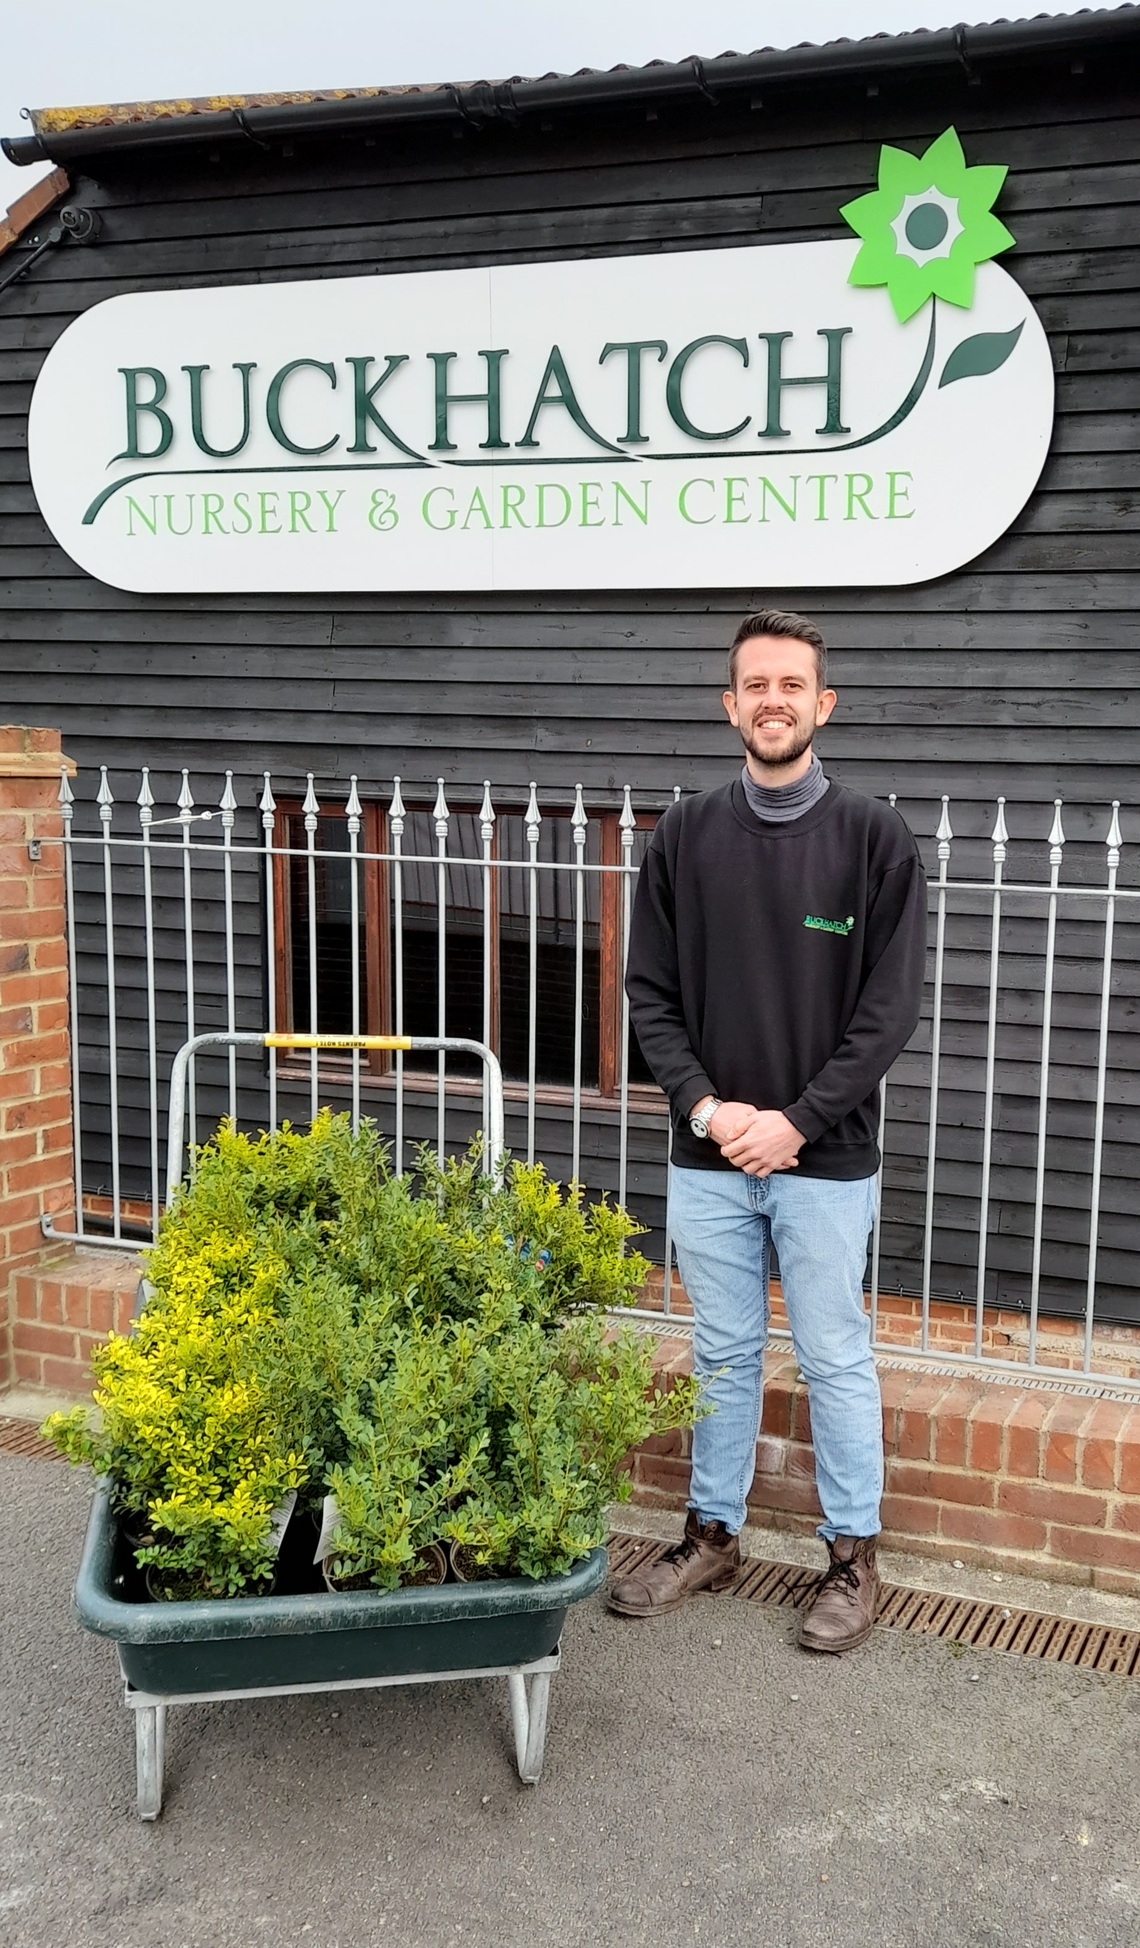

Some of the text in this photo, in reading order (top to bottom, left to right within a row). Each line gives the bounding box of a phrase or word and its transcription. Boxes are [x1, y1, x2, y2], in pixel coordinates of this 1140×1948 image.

[105, 326, 853, 470] BUCKHATCH
[126, 470, 917, 537] NURSERY & GARDEN CENTRE
